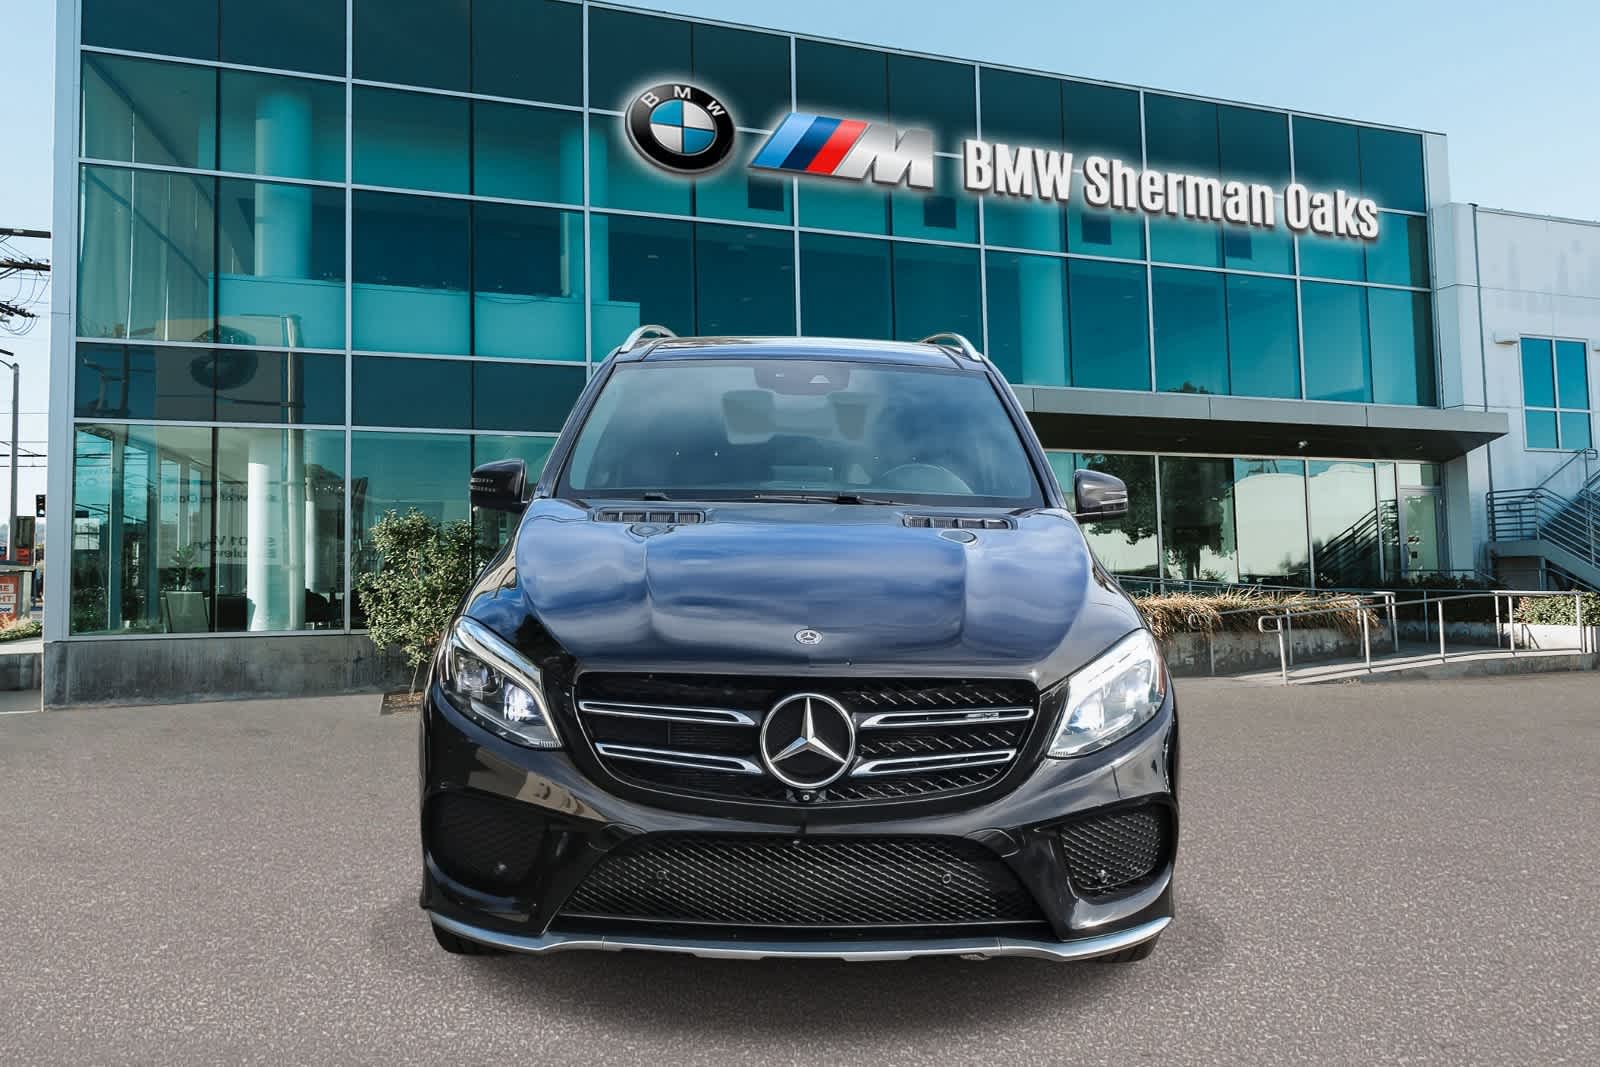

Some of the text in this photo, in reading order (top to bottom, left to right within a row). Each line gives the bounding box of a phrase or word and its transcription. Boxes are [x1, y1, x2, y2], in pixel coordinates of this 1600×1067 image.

[641, 84, 726, 118] BMW
[964, 139, 1380, 241] BMW Sherman Oaks
